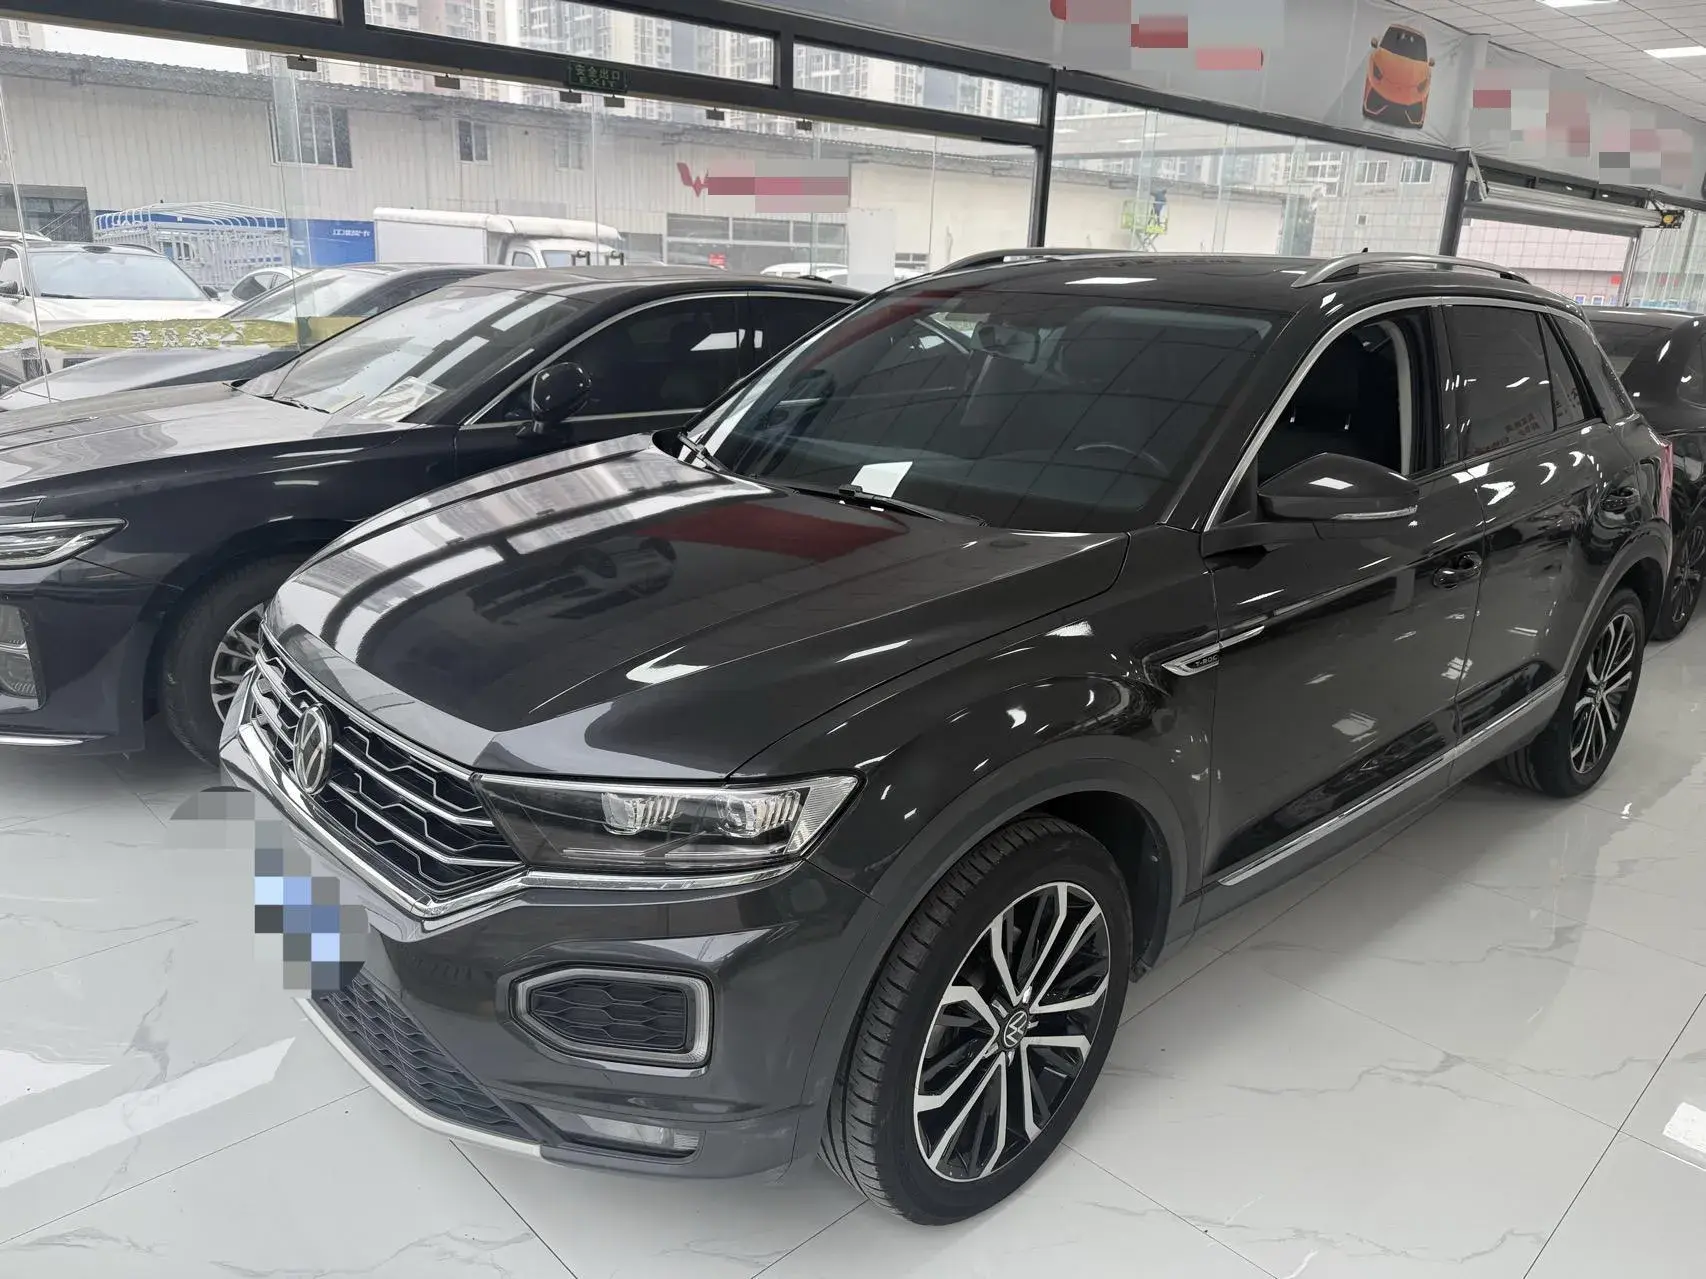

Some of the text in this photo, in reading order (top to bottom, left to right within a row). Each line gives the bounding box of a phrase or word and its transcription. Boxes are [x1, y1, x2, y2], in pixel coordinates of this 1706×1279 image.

[575, 64, 620, 81] 安全出口
[579, 77, 616, 88] EXIT
[1195, 654, 1218, 668] T-ROC
